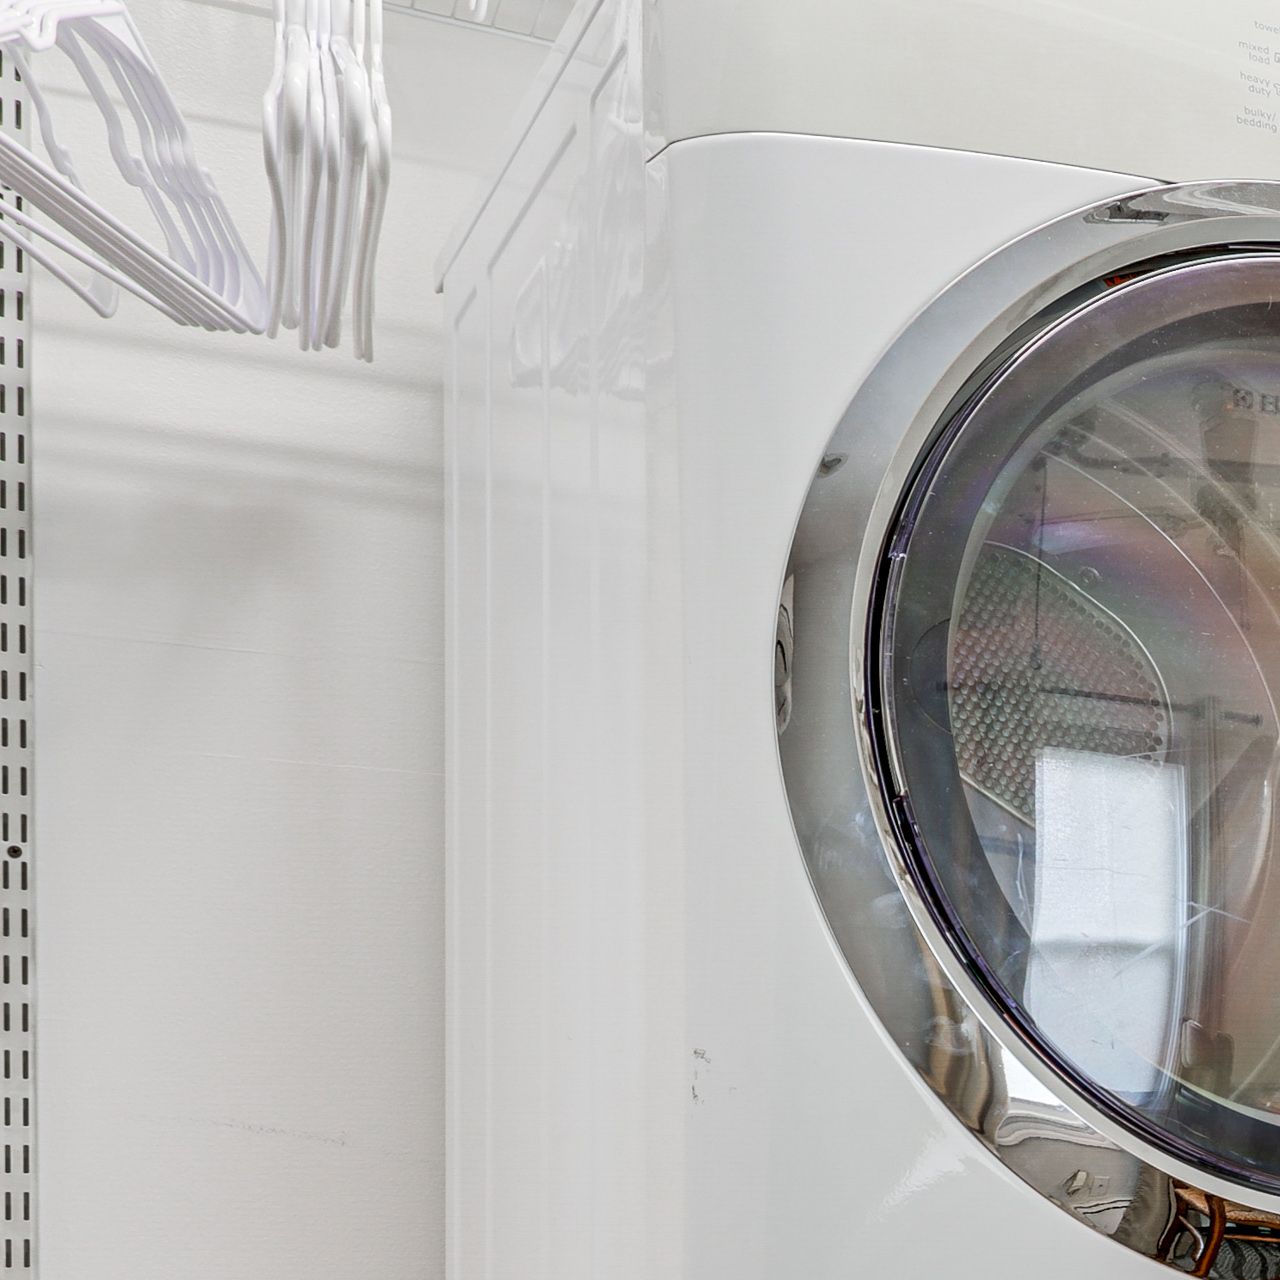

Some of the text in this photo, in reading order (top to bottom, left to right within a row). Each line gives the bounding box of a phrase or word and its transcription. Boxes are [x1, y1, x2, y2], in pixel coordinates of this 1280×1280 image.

[1238, 40, 1269, 54] mixed
[1249, 51, 1270, 65] load
[1240, 71, 1270, 87] heavy
[1248, 82, 1271, 98] duty
[1244, 106, 1276, 121] bulky/
[1236, 115, 1277, 133] bedding
